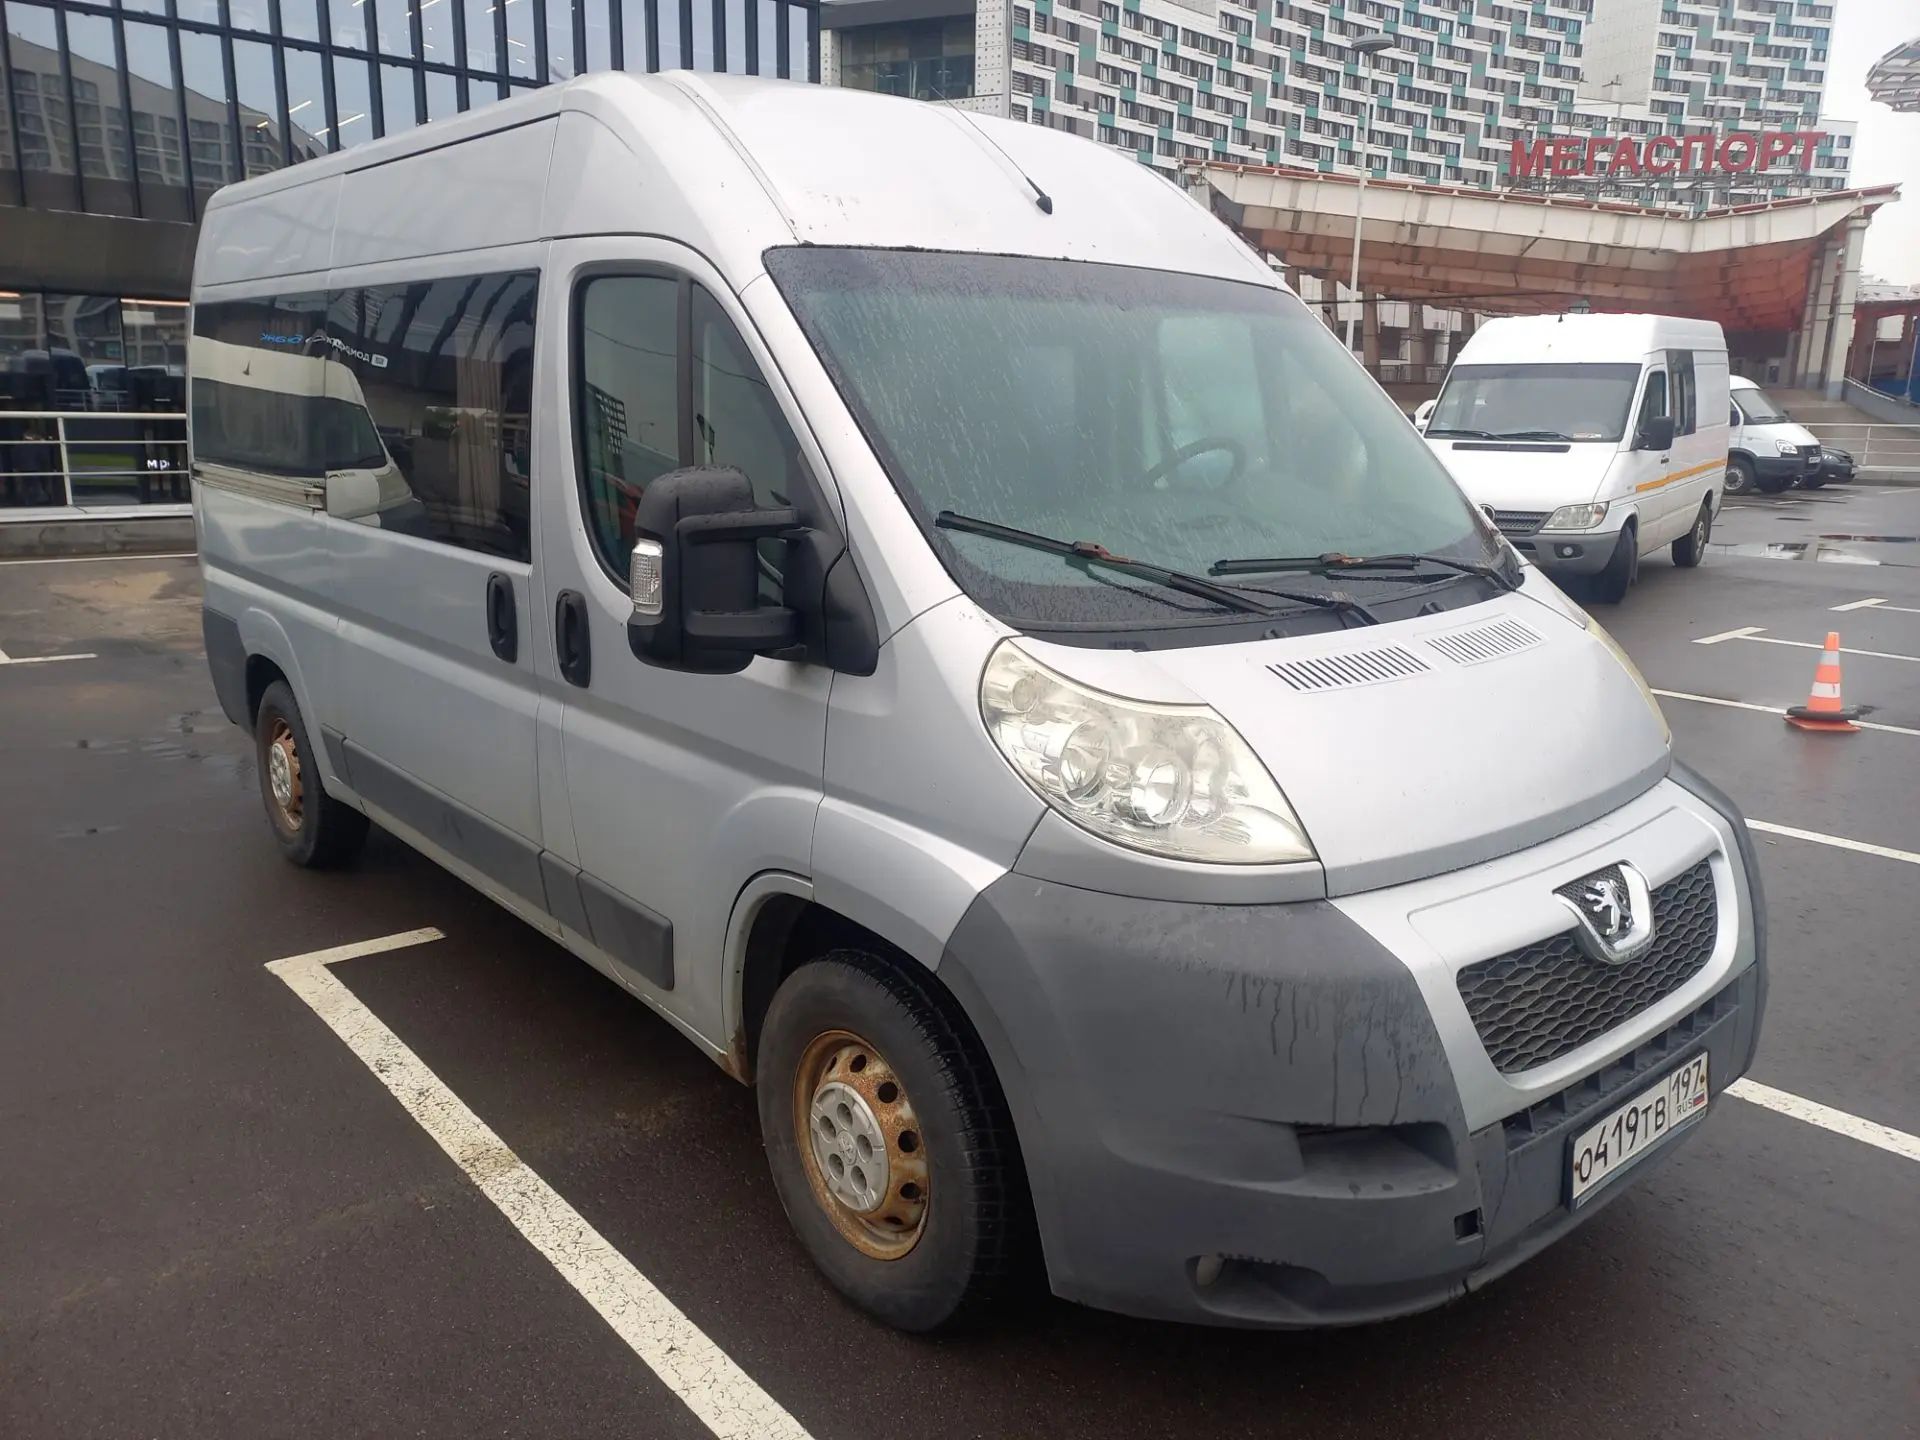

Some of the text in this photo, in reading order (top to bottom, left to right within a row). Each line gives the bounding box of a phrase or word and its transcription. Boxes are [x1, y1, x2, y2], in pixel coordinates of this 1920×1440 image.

[1510, 131, 1826, 176] МЕГАСПОРТ
[1672, 1059, 1702, 1104] 197
[1676, 1098, 1693, 1116] RUS
